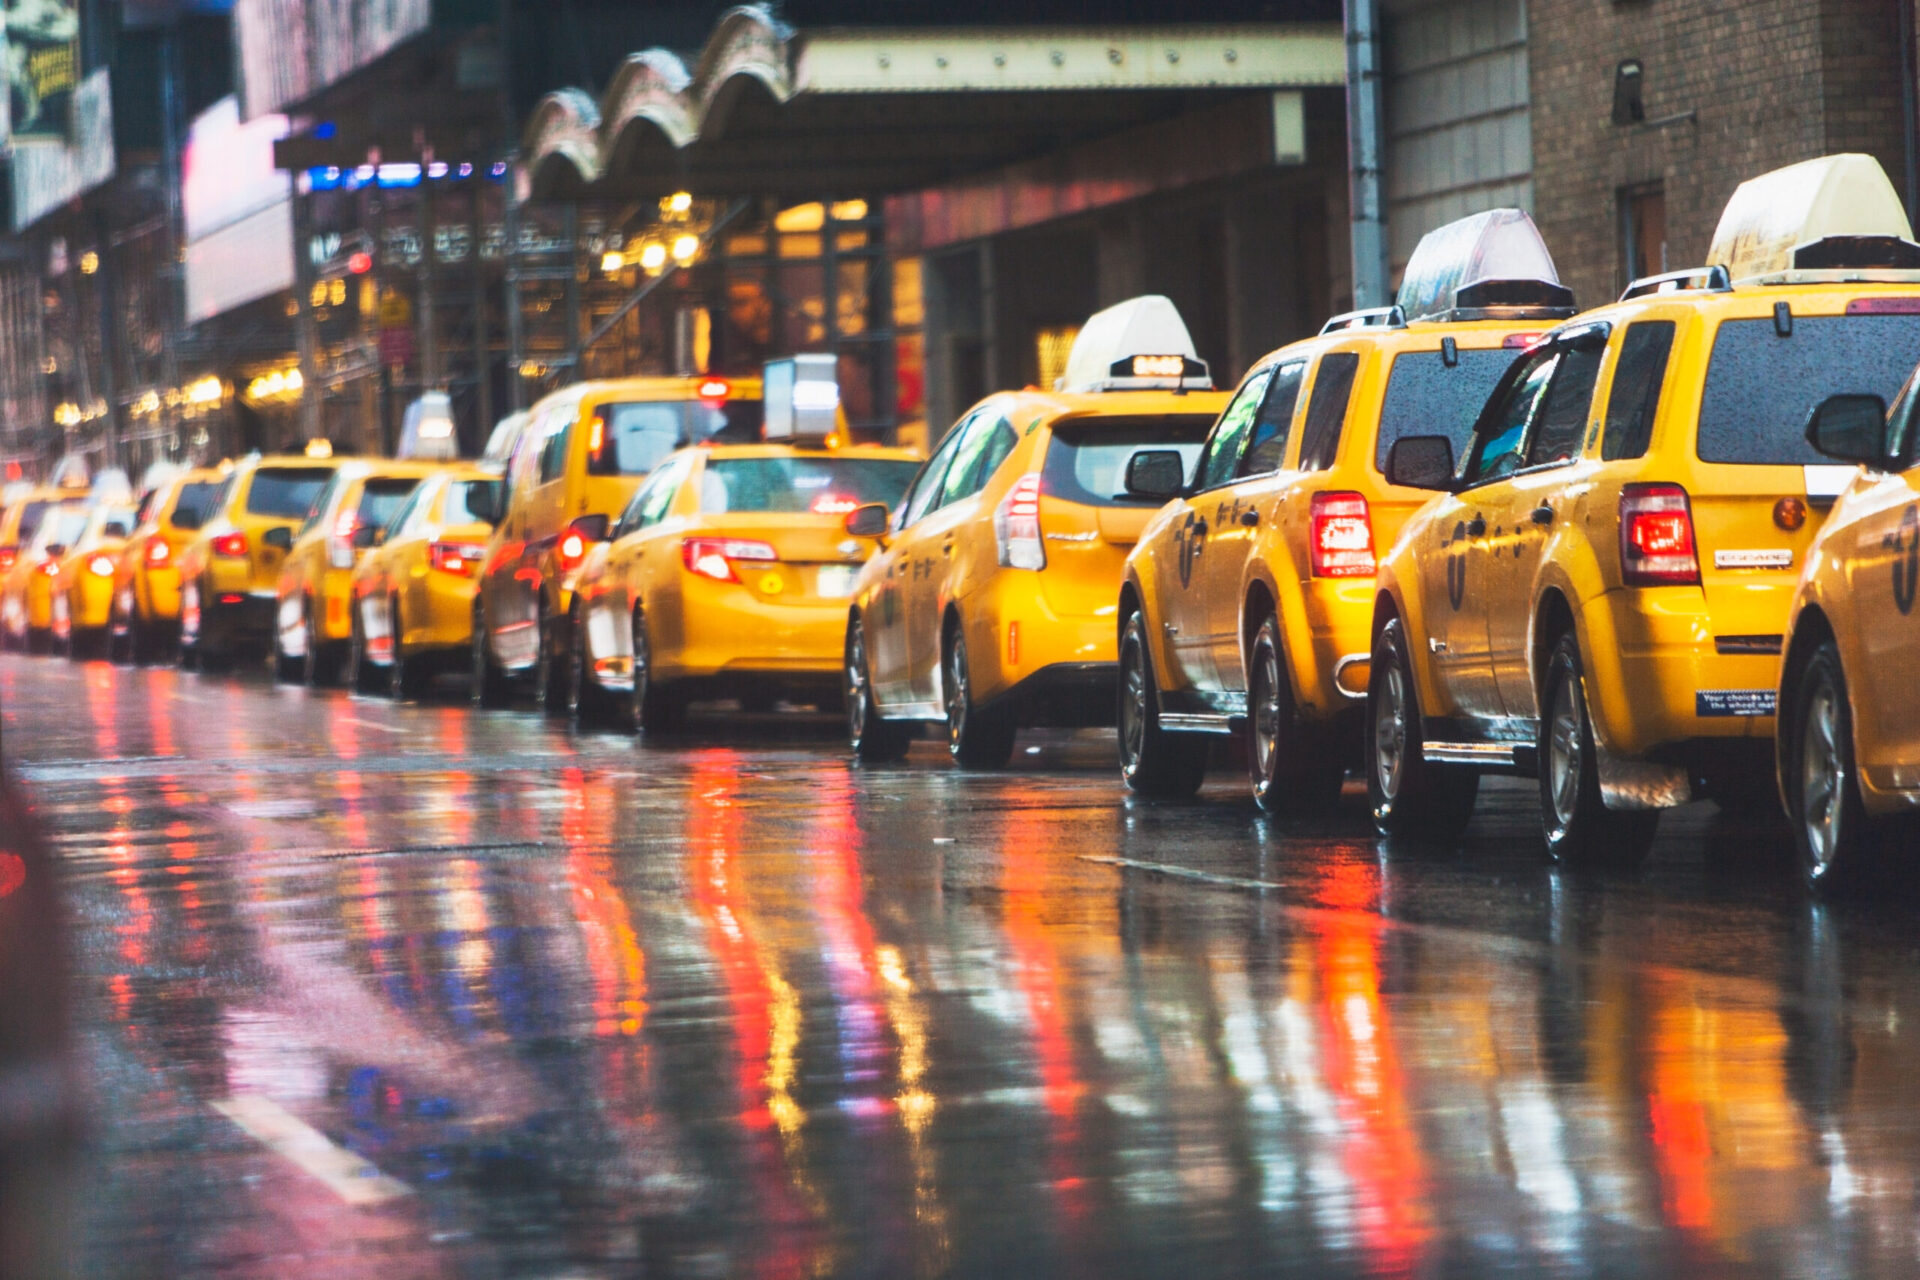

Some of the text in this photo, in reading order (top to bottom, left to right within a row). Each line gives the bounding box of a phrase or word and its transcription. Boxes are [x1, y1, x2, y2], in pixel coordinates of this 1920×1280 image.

[1703, 694, 1724, 702] Your
[1726, 693, 1762, 702] choices
[1710, 702, 1726, 710] the
[1728, 702, 1756, 710] wheel
